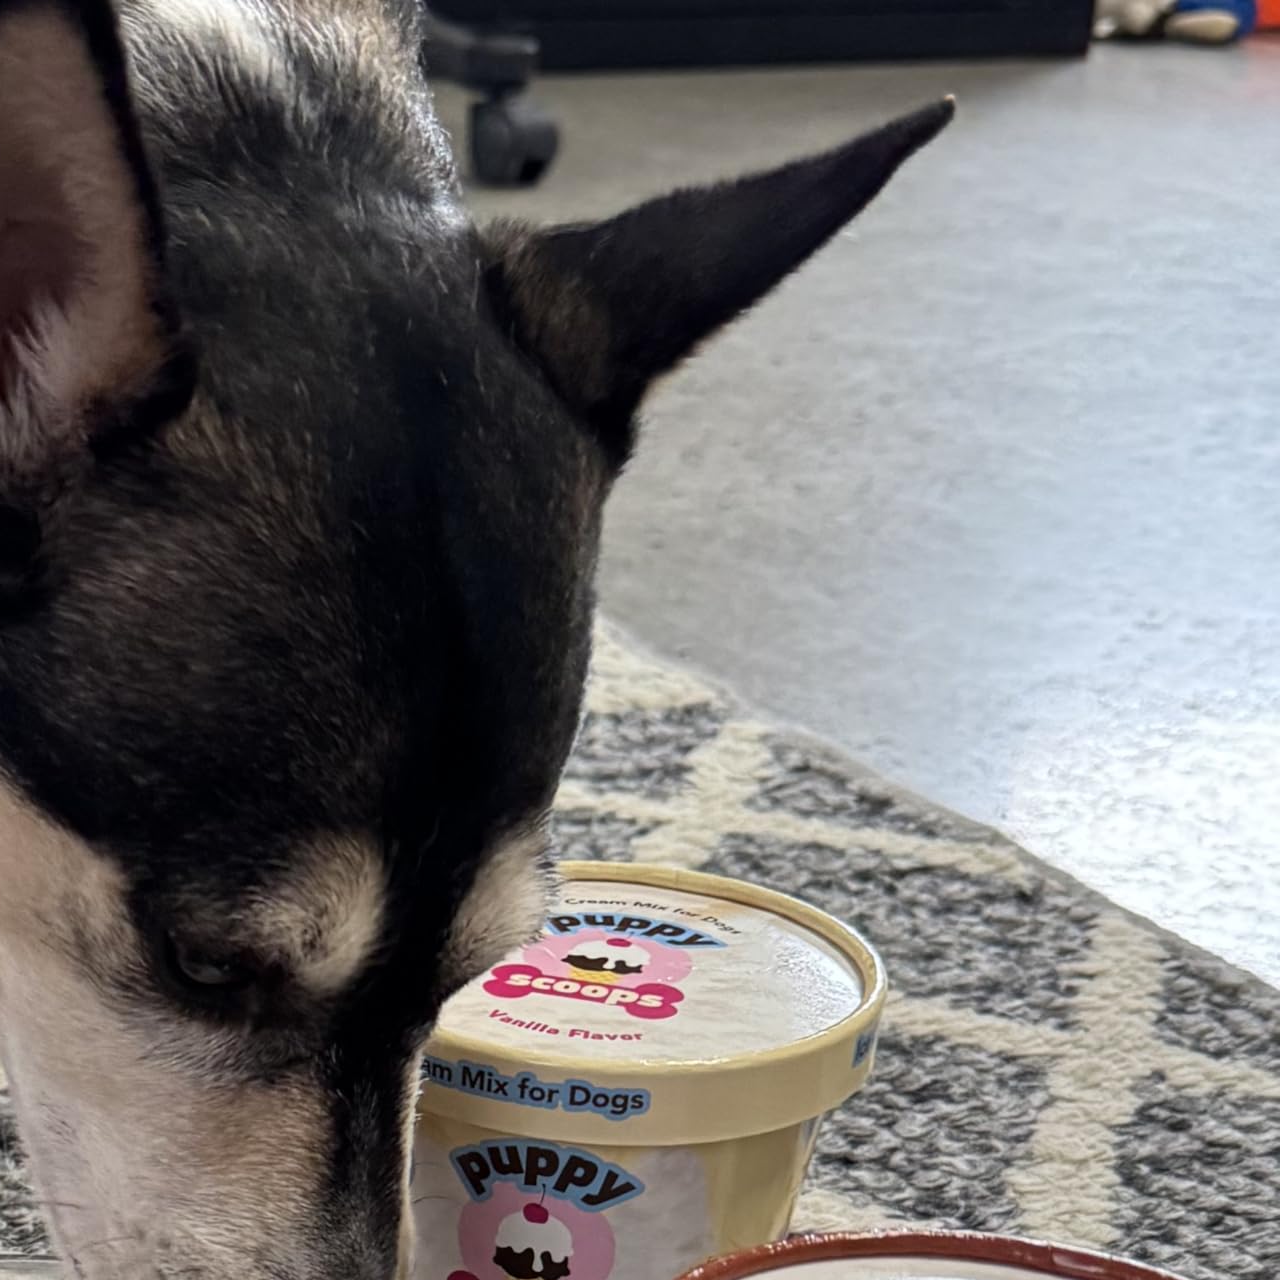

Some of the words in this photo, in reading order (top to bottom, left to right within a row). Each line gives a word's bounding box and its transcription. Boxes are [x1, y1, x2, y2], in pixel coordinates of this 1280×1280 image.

[549, 914, 719, 947] puppy
[564, 896, 627, 906] Cream
[633, 901, 669, 912] Mix
[673, 907, 699, 918] for
[701, 915, 743, 935] Dogs
[503, 972, 666, 1009] scoops
[488, 1009, 561, 1035] Vanilla
[568, 1028, 644, 1042] Flavor
[462, 1066, 509, 1096] Mix
[518, 1079, 561, 1104] for
[569, 1086, 645, 1114] Dogs
[456, 1144, 636, 1206] puppy
